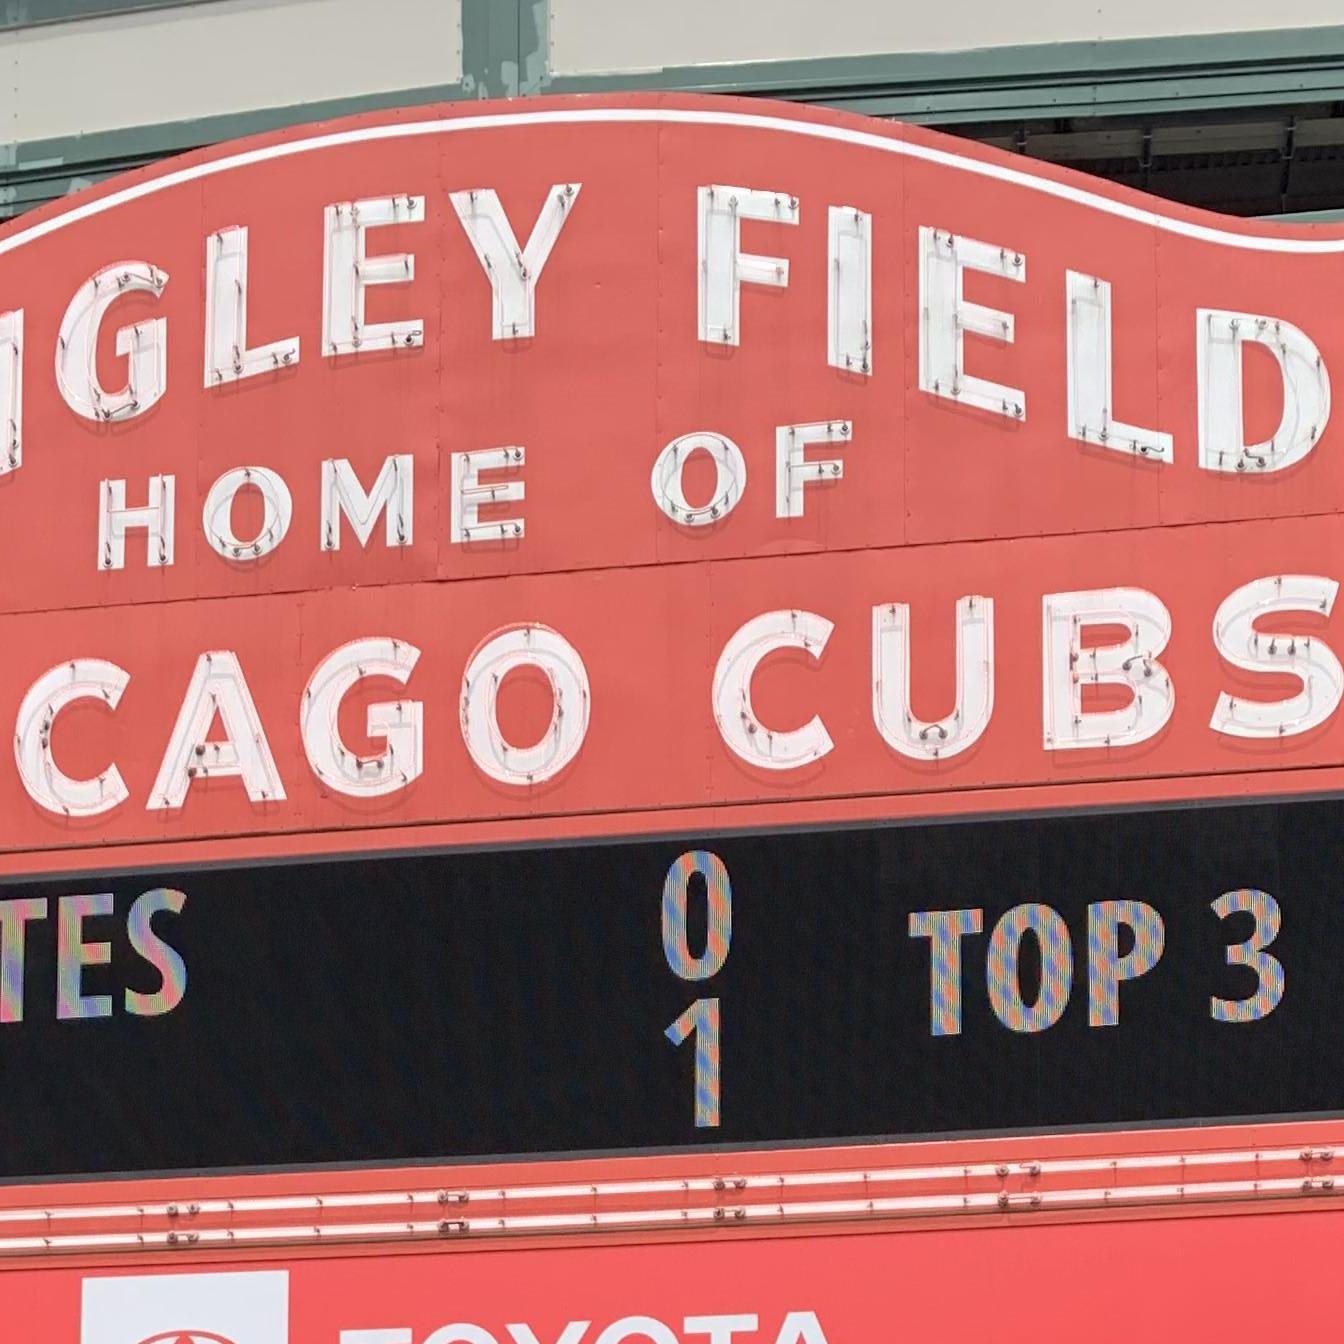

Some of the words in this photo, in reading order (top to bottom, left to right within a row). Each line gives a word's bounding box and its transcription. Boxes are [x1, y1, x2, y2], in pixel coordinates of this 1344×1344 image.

[697, 184, 1331, 474] FIELD
[97, 444, 527, 571] HOME
[651, 420, 852, 526] OF
[712, 575, 1344, 770] CUBS
[662, 850, 732, 983] 0
[910, 899, 1164, 1038] TOP
[1210, 888, 1285, 1023] 3
[665, 997, 719, 1129] 1
